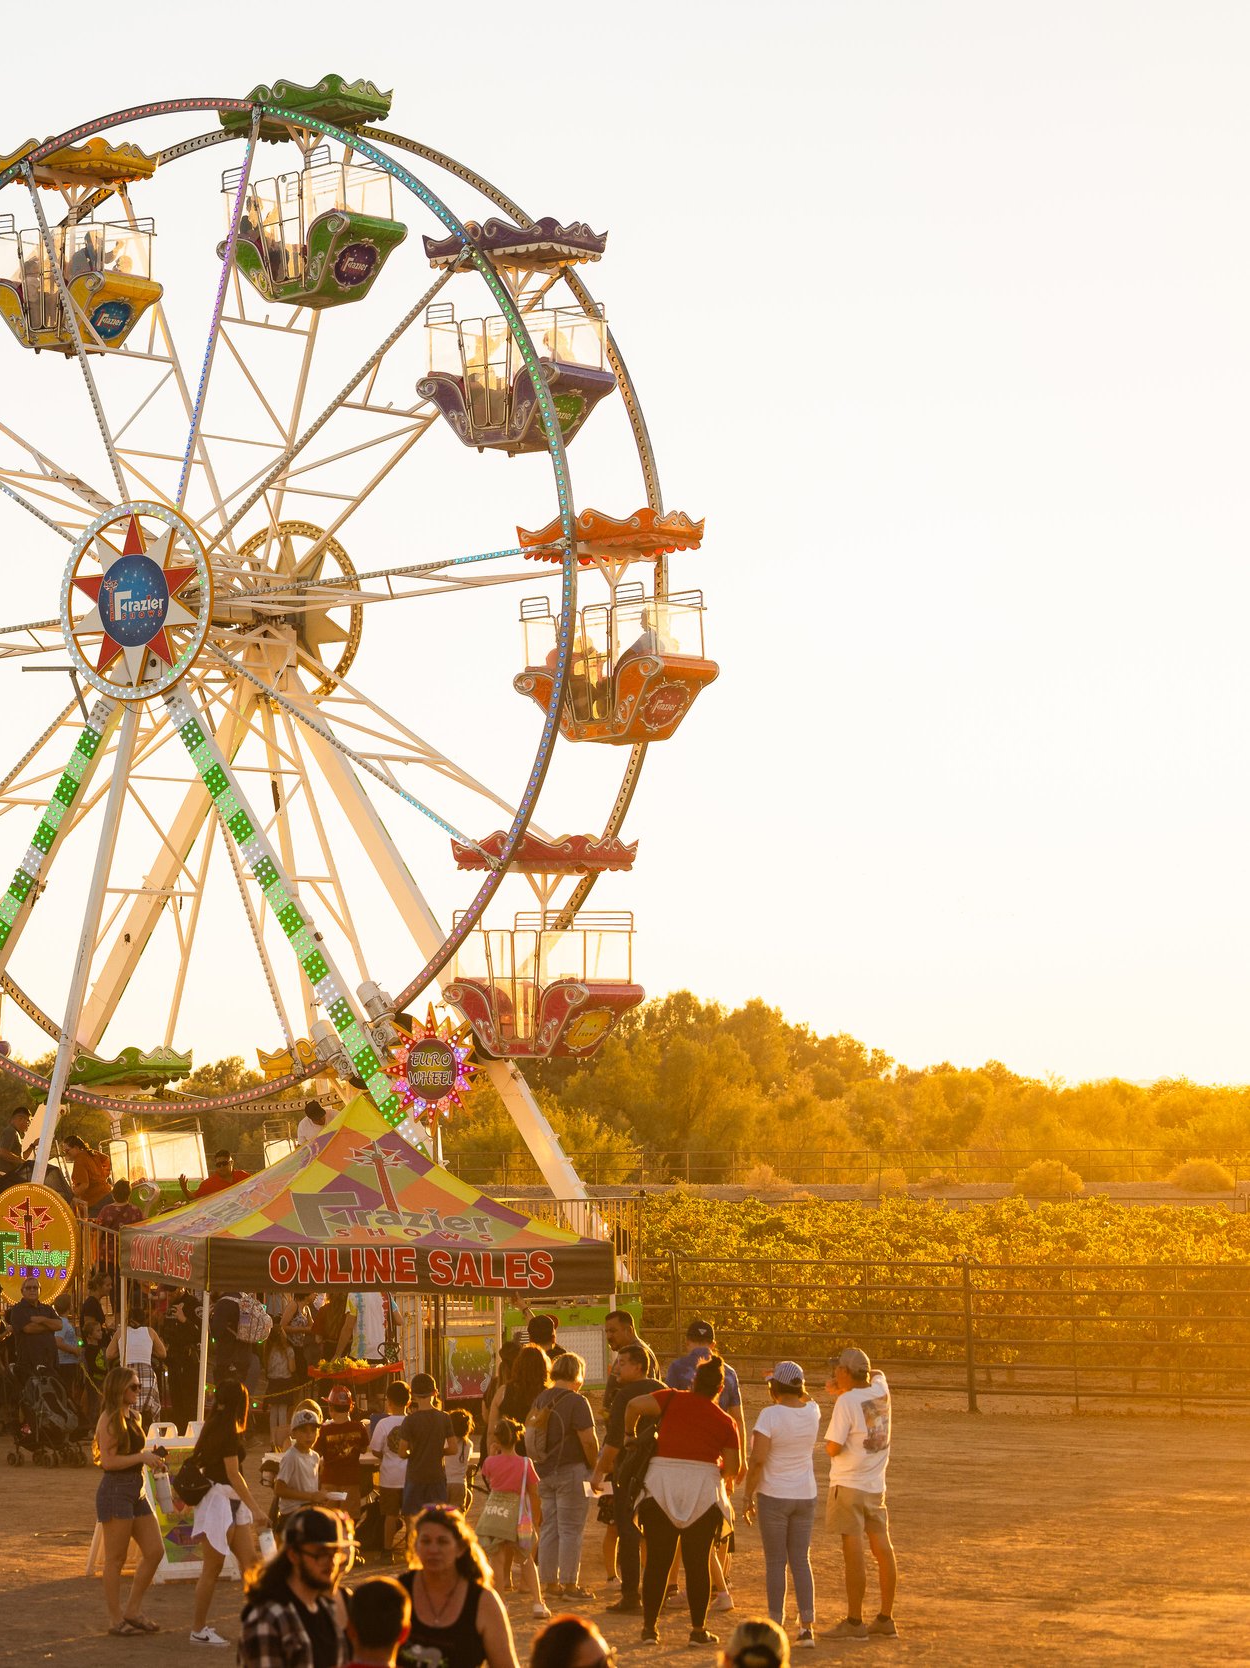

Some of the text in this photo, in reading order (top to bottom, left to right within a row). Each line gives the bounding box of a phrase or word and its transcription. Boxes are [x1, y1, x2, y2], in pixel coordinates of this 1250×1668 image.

[114, 590, 164, 621] Frazier
[410, 1051, 452, 1067] EURO
[407, 1070, 454, 1087] WHEEL
[290, 1191, 493, 1239] Frazier
[334, 1227, 494, 1243] SHOWS
[130, 1234, 195, 1281] ONLINE SALES
[268, 1246, 555, 1290] ONLINE SALES
[8, 1266, 67, 1279] SHOWS
